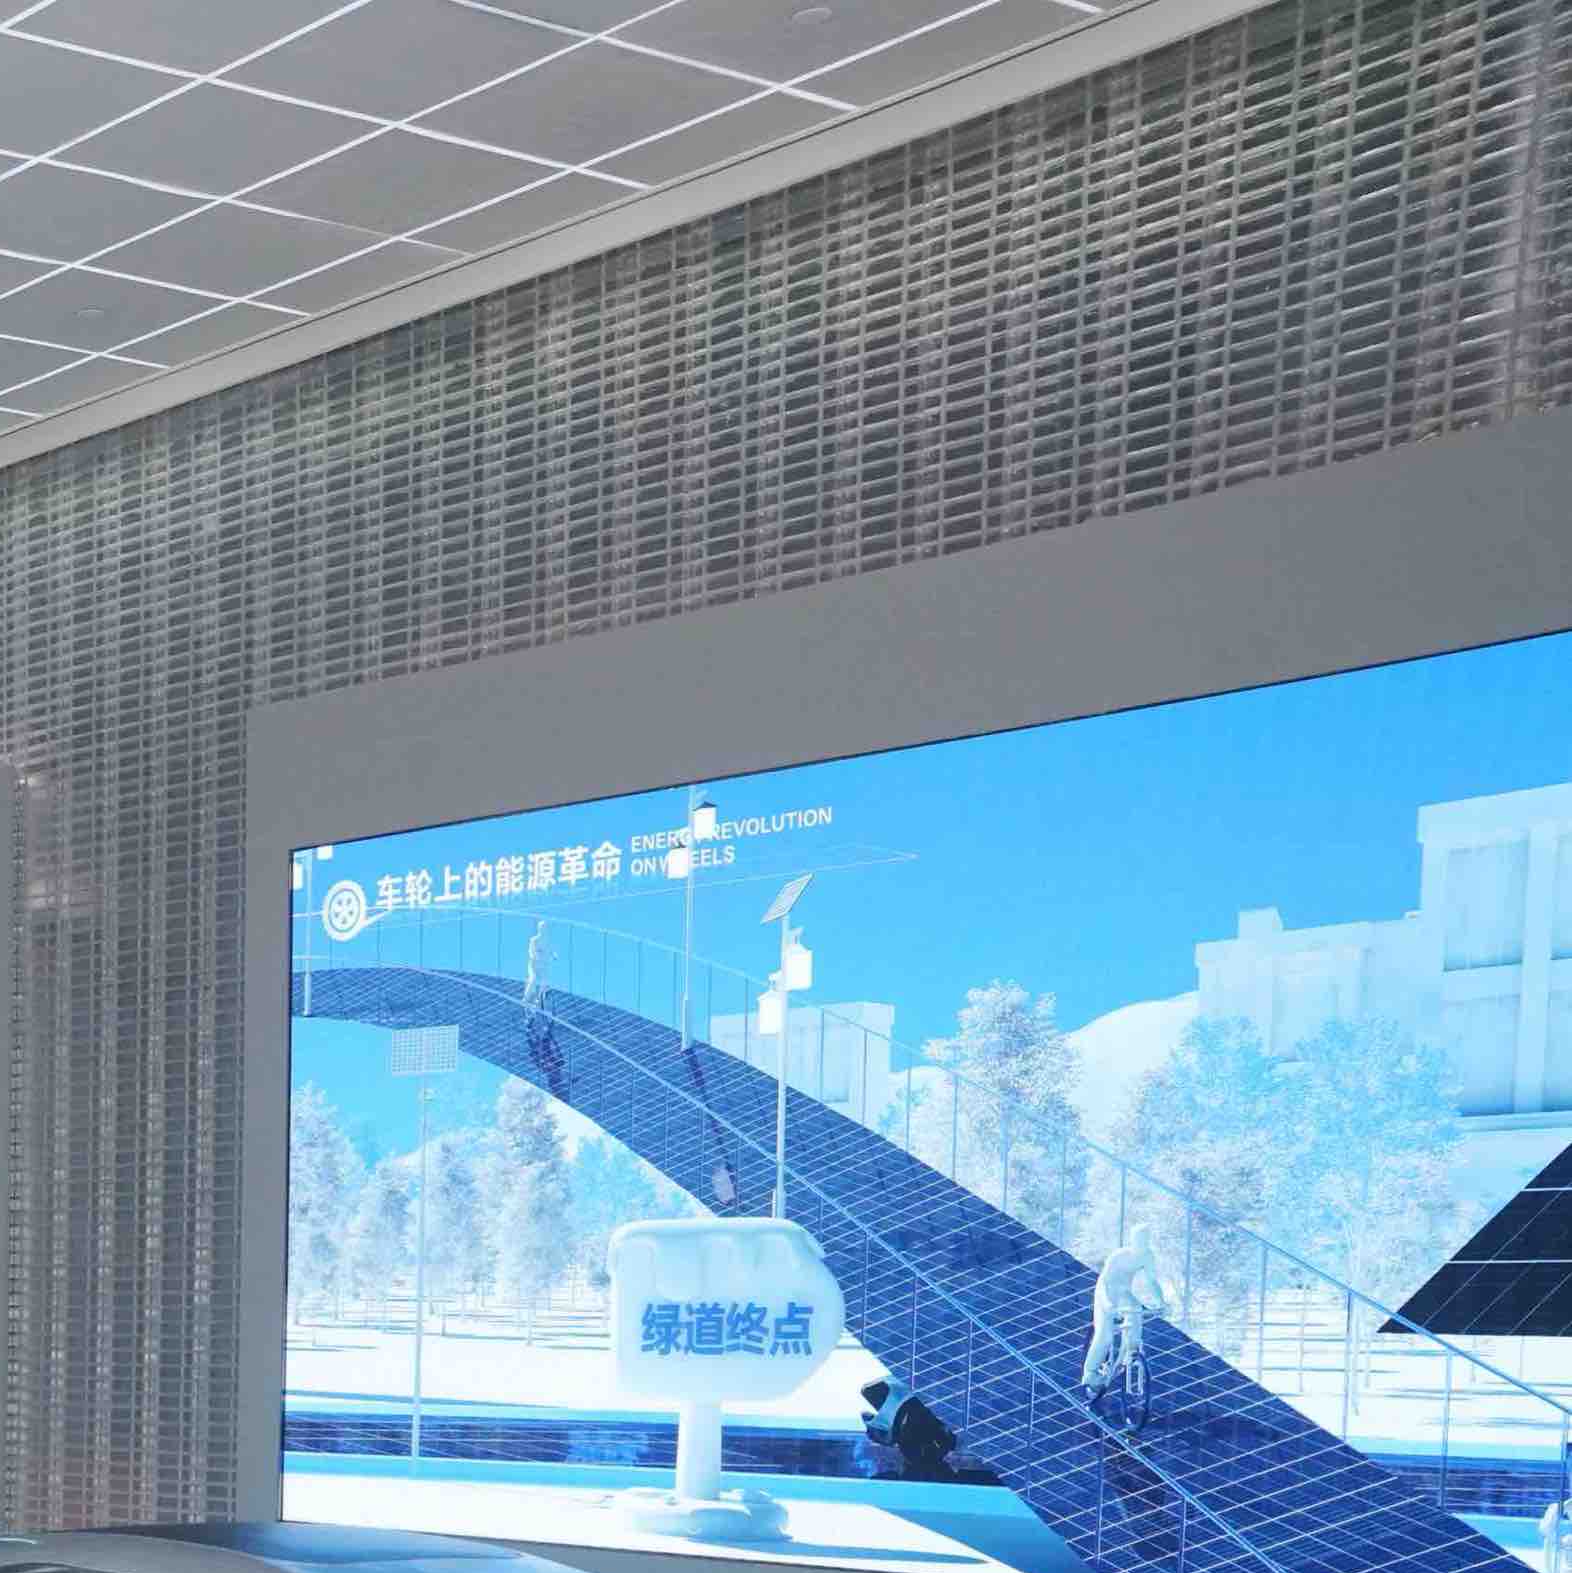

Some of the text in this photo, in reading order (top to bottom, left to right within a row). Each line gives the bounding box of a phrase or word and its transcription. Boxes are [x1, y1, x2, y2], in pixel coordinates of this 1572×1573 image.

[375, 839, 623, 911] 车轮上的能源革命
[631, 845, 736, 876] ON EELS
[641, 1301, 814, 1356] 绿道终点
